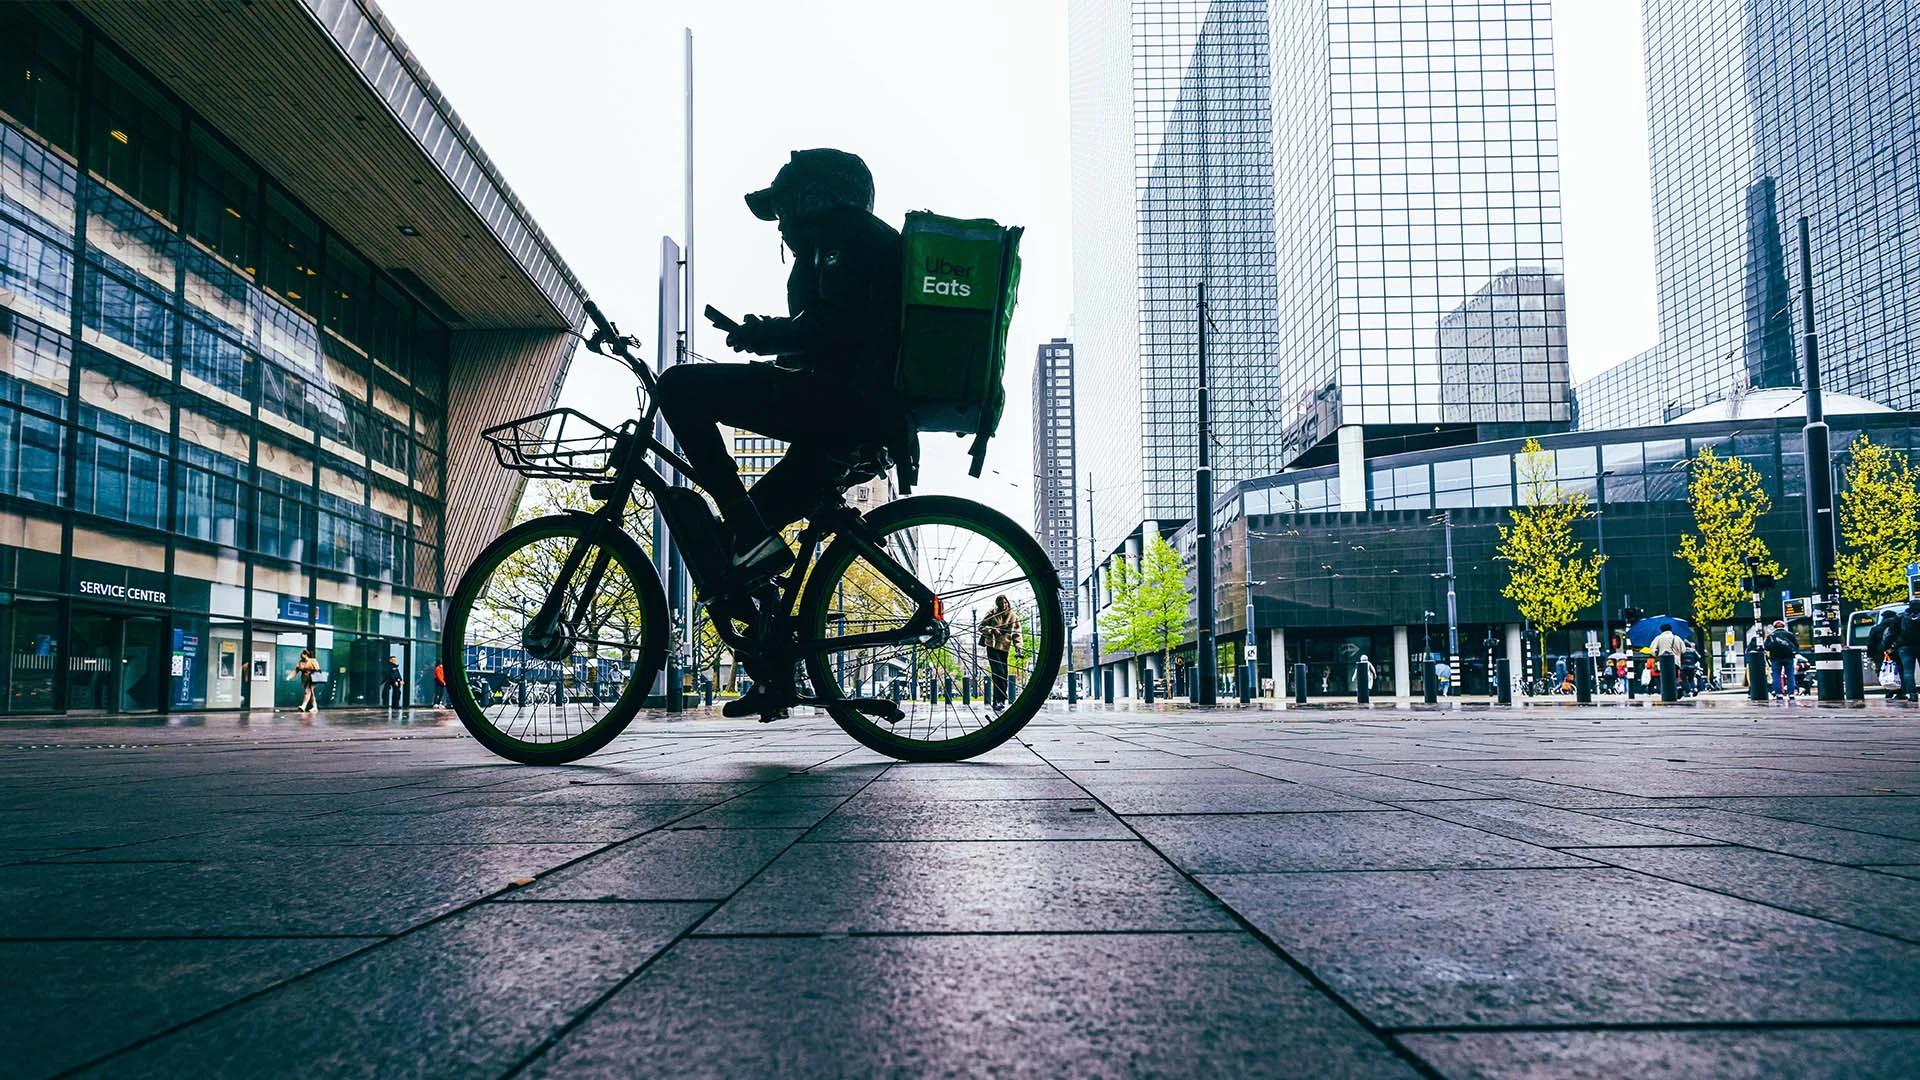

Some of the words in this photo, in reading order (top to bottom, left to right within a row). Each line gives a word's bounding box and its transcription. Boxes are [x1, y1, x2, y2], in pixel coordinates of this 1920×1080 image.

[925, 256, 974, 277] Uber
[922, 276, 971, 297] Eats
[80, 580, 125, 598] SERVICE
[127, 587, 166, 604] CENTER
